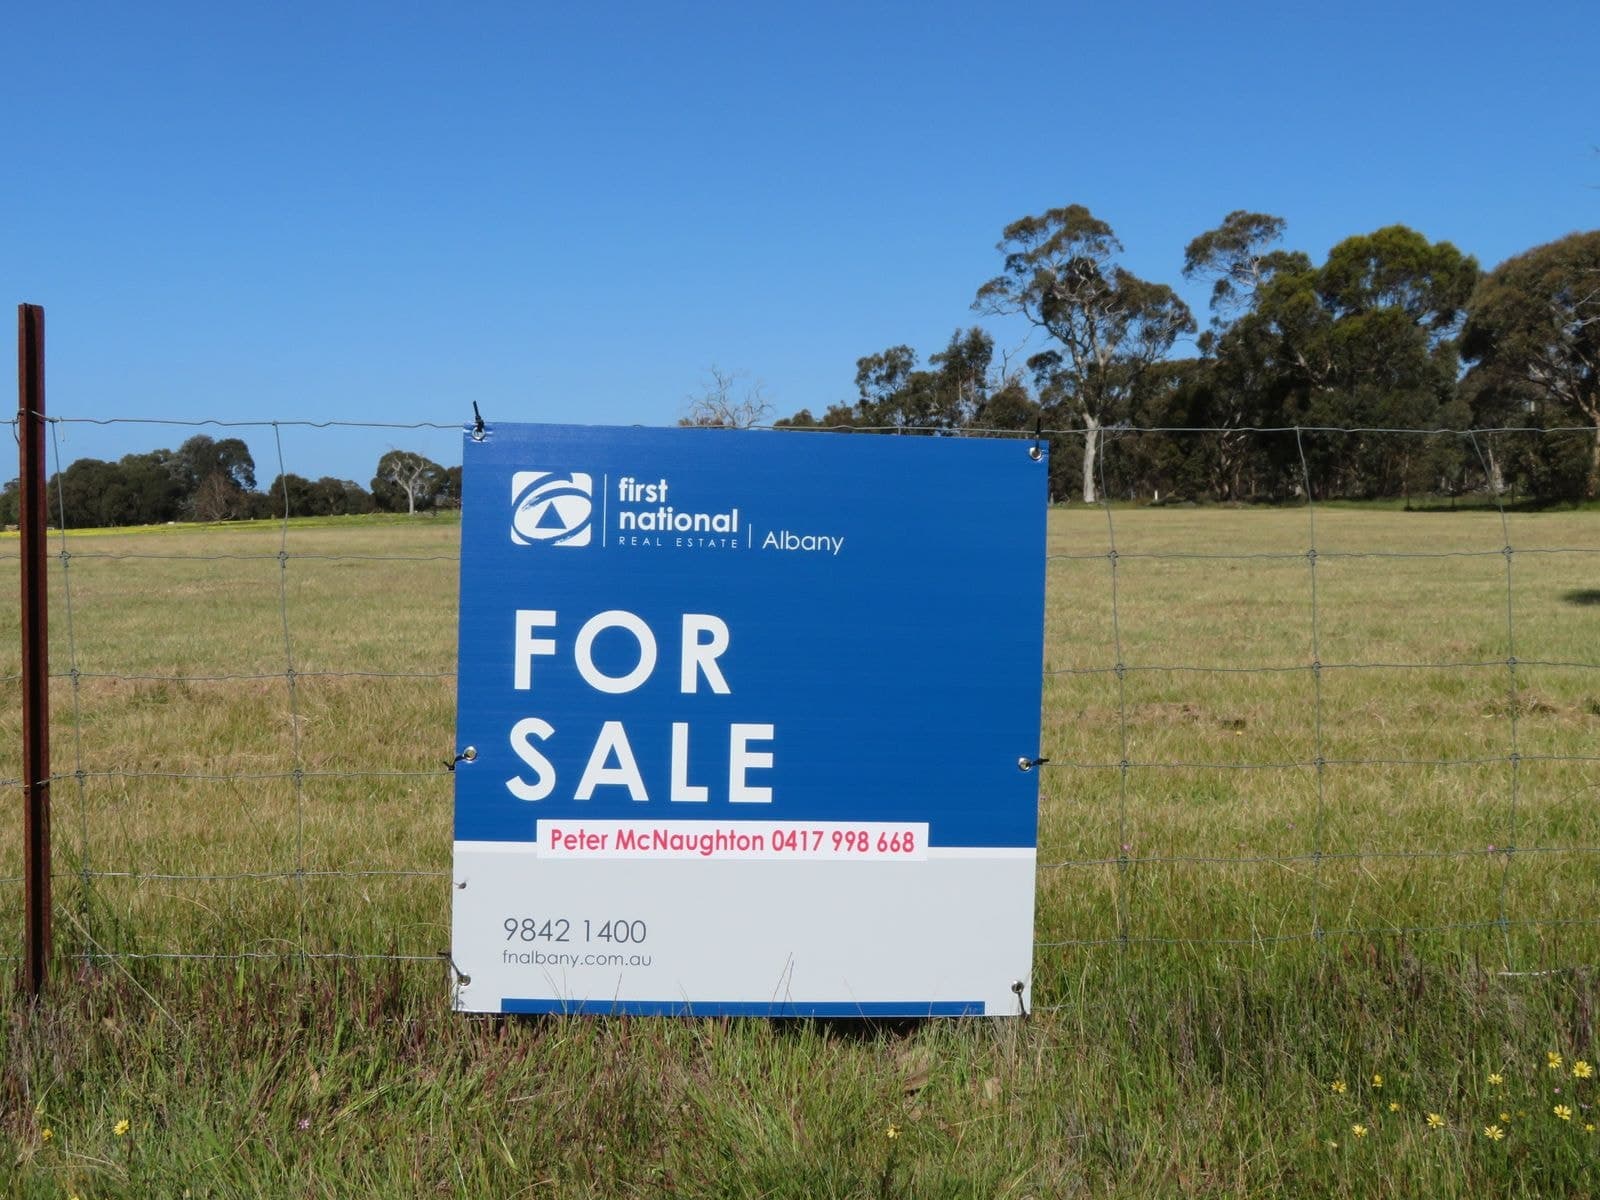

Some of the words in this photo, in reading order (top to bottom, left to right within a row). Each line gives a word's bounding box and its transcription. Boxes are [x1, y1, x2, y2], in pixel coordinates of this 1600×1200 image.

[618, 477, 669, 503] first
[619, 507, 738, 533] national
[618, 535, 663, 547] REAL
[675, 537, 738, 549] ESTATE
[762, 530, 844, 555] Albany
[514, 609, 732, 695] FOR
[506, 717, 776, 804] SALE
[550, 829, 608, 850] Peter
[615, 830, 765, 857] McNaughton
[771, 830, 825, 852] 0417
[831, 830, 870, 853] 998
[876, 832, 915, 854] 668
[503, 917, 570, 943] 9842
[582, 918, 648, 944] 1400
[502, 950, 652, 969] fnalbany.com.au
